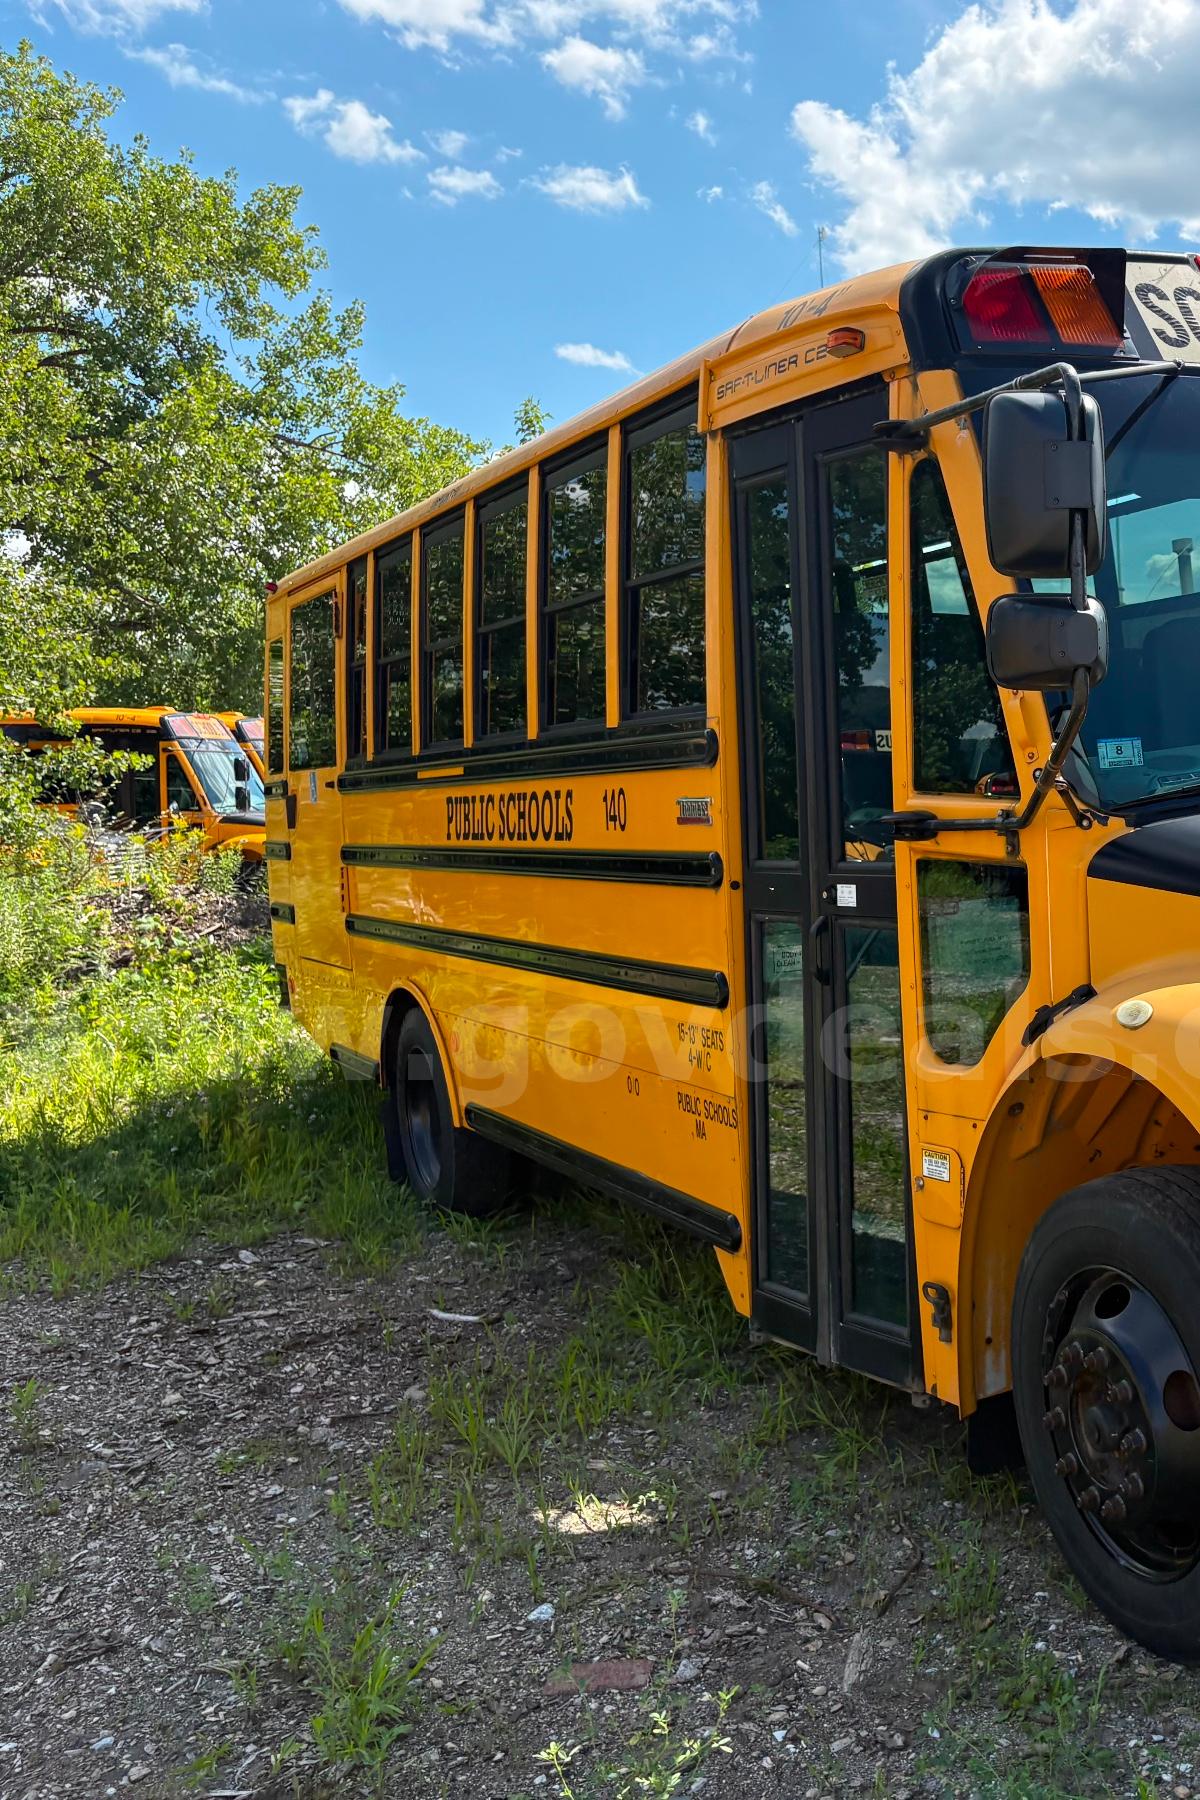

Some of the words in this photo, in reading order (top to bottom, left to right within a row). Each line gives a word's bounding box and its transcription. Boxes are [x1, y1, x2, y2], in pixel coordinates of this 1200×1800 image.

[1115, 745, 1124, 756] 8
[446, 795, 495, 841] PUBLIC
[499, 789, 573, 841] SCHOOLS
[603, 787, 627, 832] 140
[701, 1027, 724, 1052] SEATS
[677, 1091, 701, 1117] PUBLIC
[703, 1099, 738, 1130] SCHOOLS
[924, 1150, 948, 1162] CAUTION
